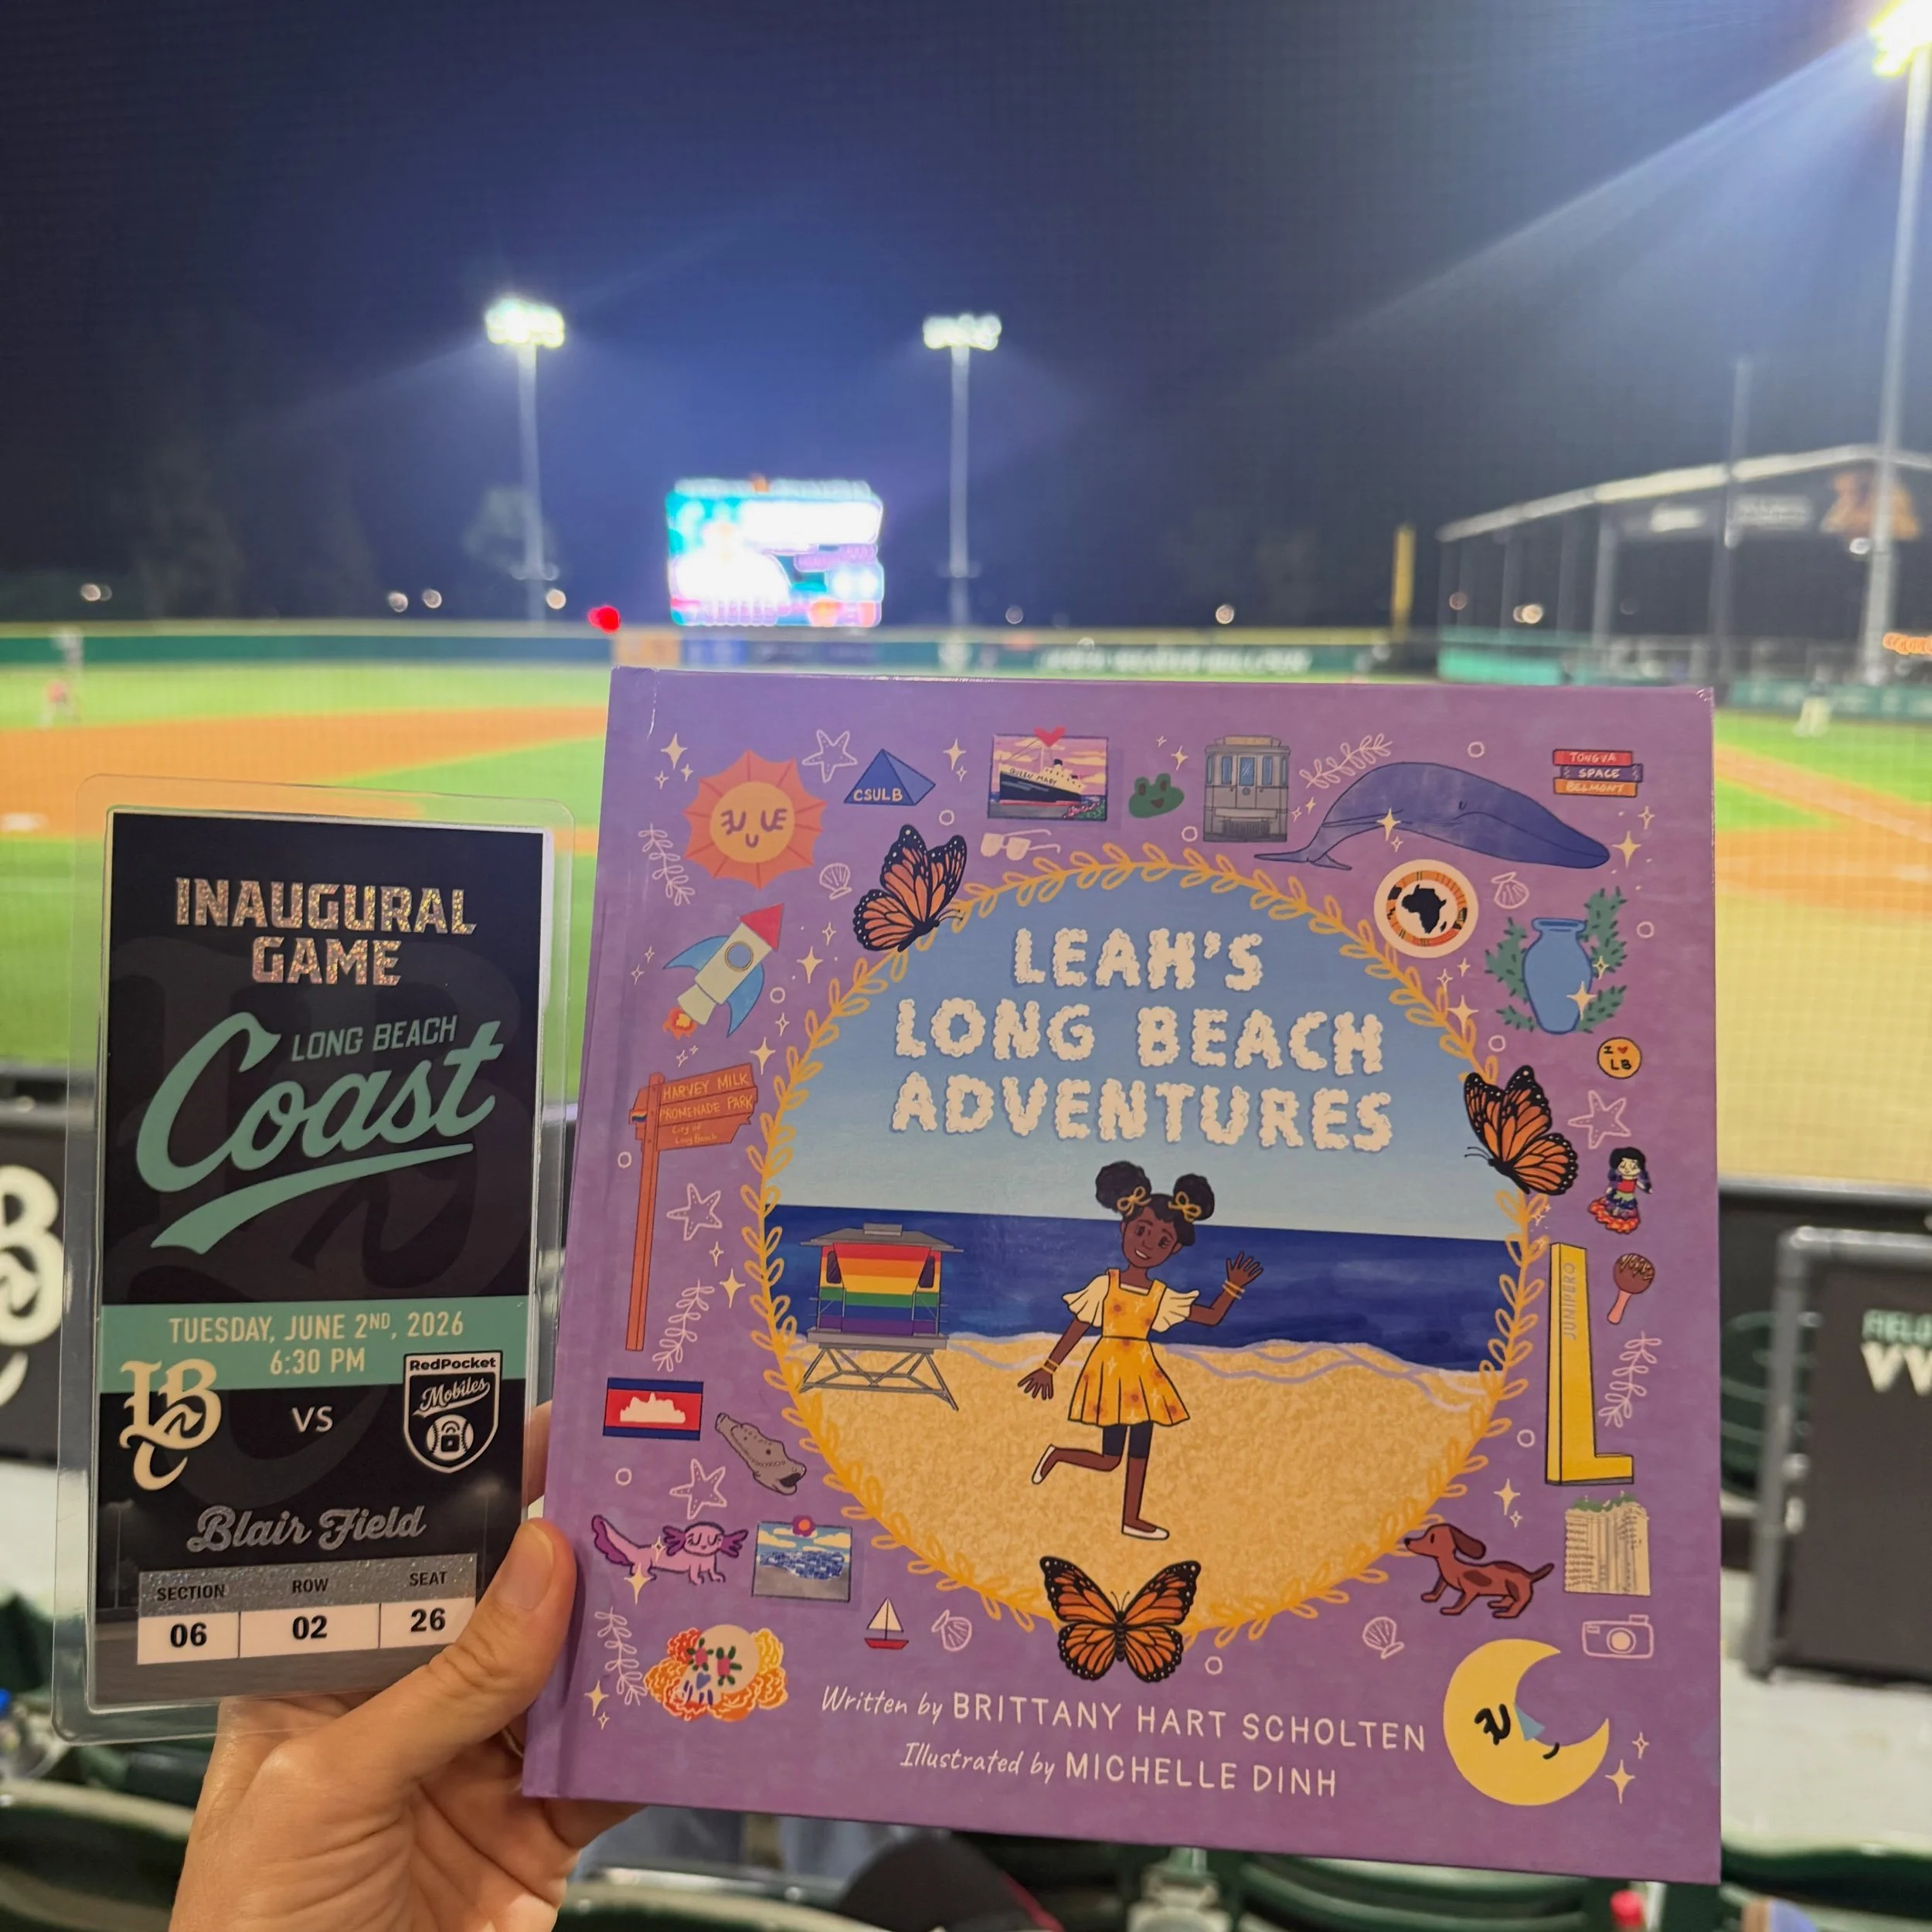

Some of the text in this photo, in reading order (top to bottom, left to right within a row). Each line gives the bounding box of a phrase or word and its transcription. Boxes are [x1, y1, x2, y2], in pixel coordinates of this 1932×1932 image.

[1570, 752, 1617, 763] TONGVA
[1578, 767, 1621, 778] SPACE
[853, 788, 903, 802] CSULB
[1565, 781, 1624, 793] BELMONT
[175, 876, 477, 935] INAUGURAL
[251, 936, 401, 986] GAME
[1013, 928, 1264, 991] LEAH'S
[291, 1015, 457, 1062] LONG BEACH
[894, 998, 1383, 1076] LONG BEACH
[1611, 1059, 1632, 1070] LB
[137, 1012, 504, 1192] Coast
[663, 1073, 750, 1100] HARVEY MILK
[660, 1094, 753, 1121] PROMENADE PARK
[891, 1071, 1393, 1152] ADVENTURES
[1562, 1262, 1577, 1341] JUNIPERO
[169, 1315, 275, 1344] TUESDAY,
[284, 1314, 345, 1341] JUNE
[407, 1311, 464, 1338] 2026
[270, 1347, 366, 1376] 6:30 PM
[410, 1357, 496, 1371] RedPocket
[419, 1376, 491, 1411] Mobiles
[186, 1505, 427, 1553] Blair Field
[157, 1571, 447, 1602] SECTION ROW SEAT
[170, 1607, 446, 1648] 06 02 26
[821, 1685, 1425, 1753] Written by BRITTANY HART SCHOLTEN
[900, 1742, 1336, 1798] Illustrated by MICHELLE DINH
